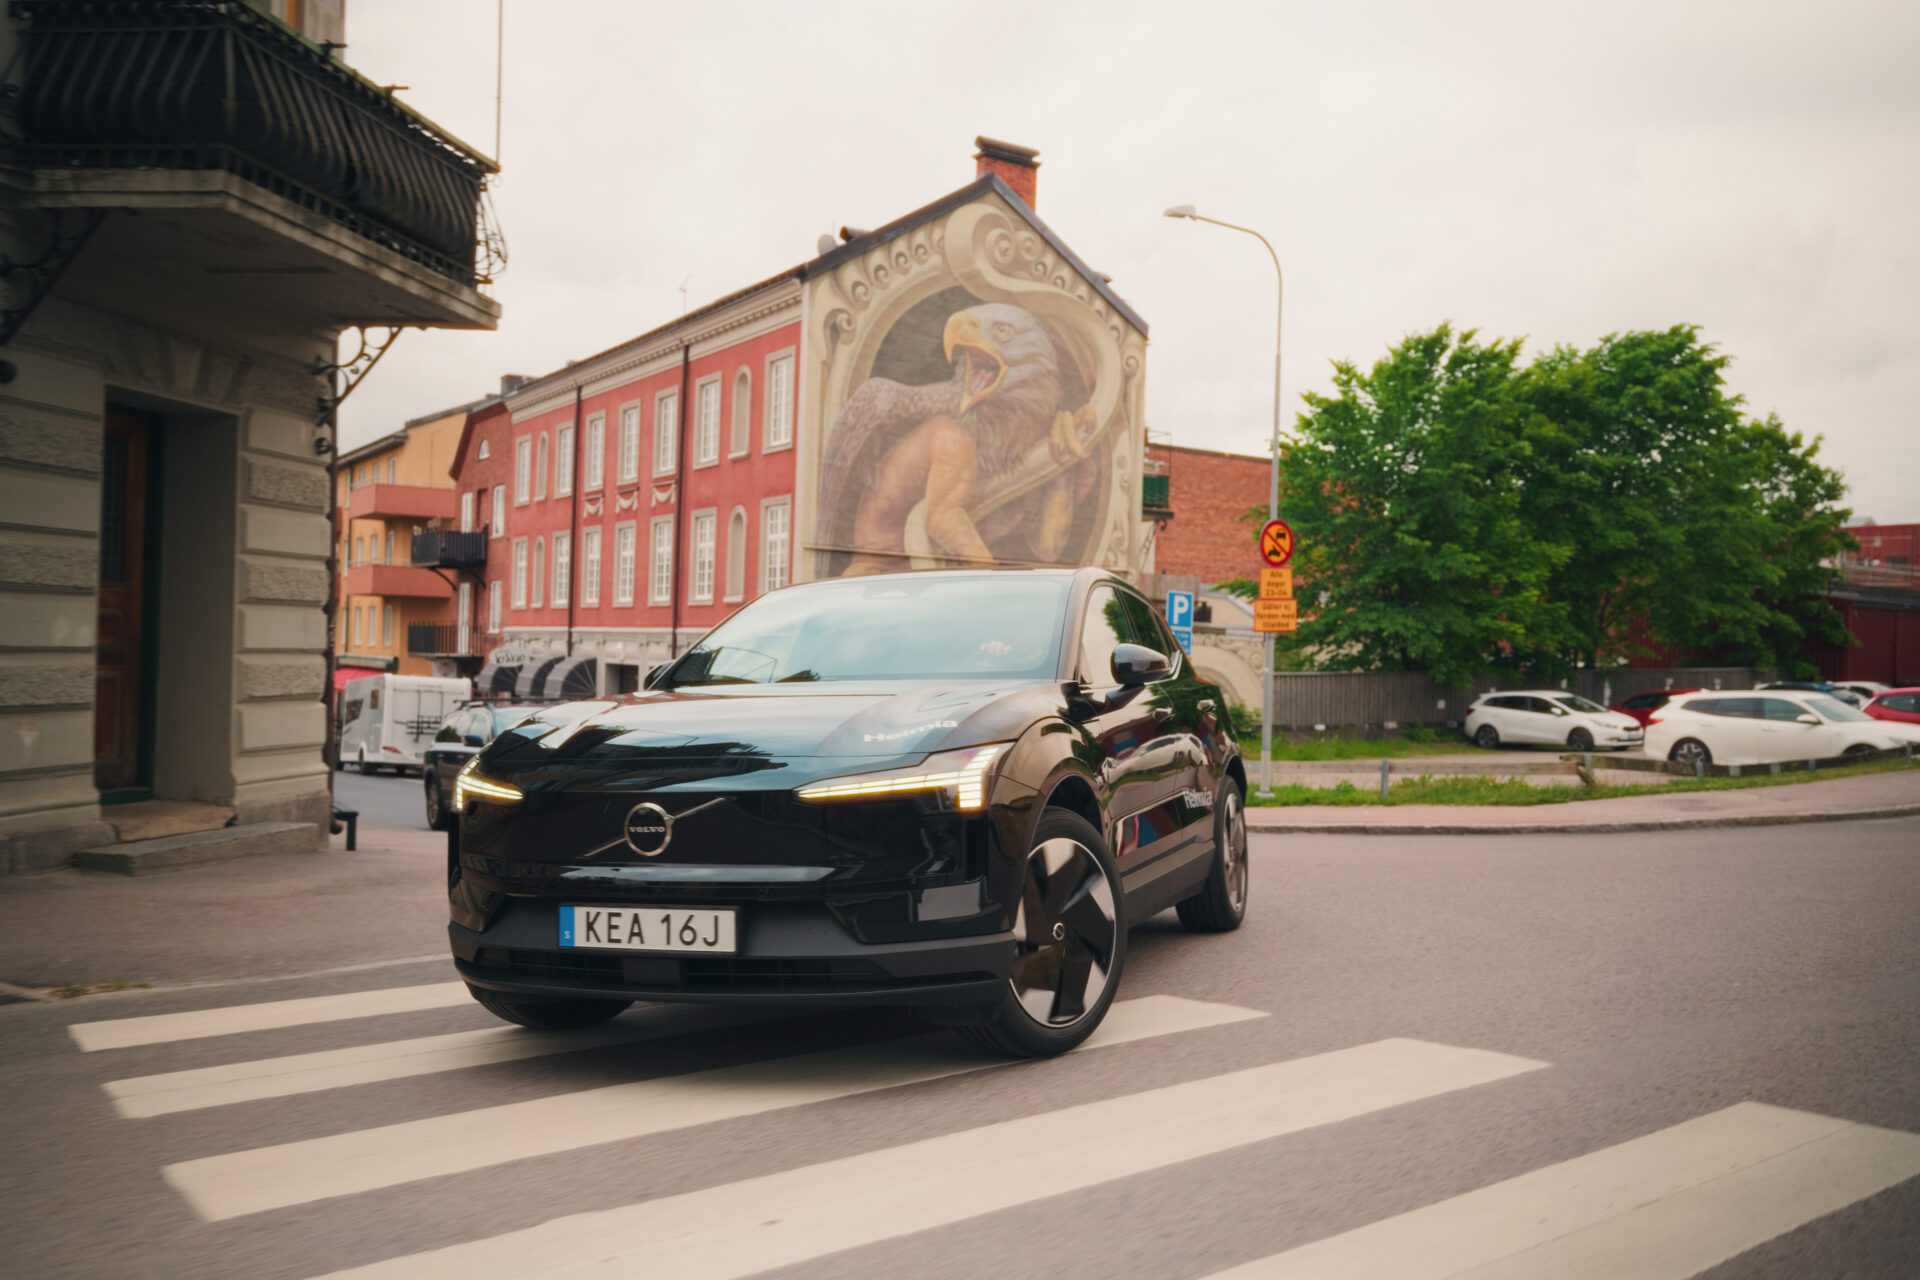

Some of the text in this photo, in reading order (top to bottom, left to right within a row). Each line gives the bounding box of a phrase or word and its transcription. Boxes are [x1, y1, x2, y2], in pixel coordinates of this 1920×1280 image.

[1173, 594, 1190, 625] P
[863, 721, 958, 742] Helmia
[564, 931, 571, 939] S
[585, 910, 719, 946] KEA 16J
